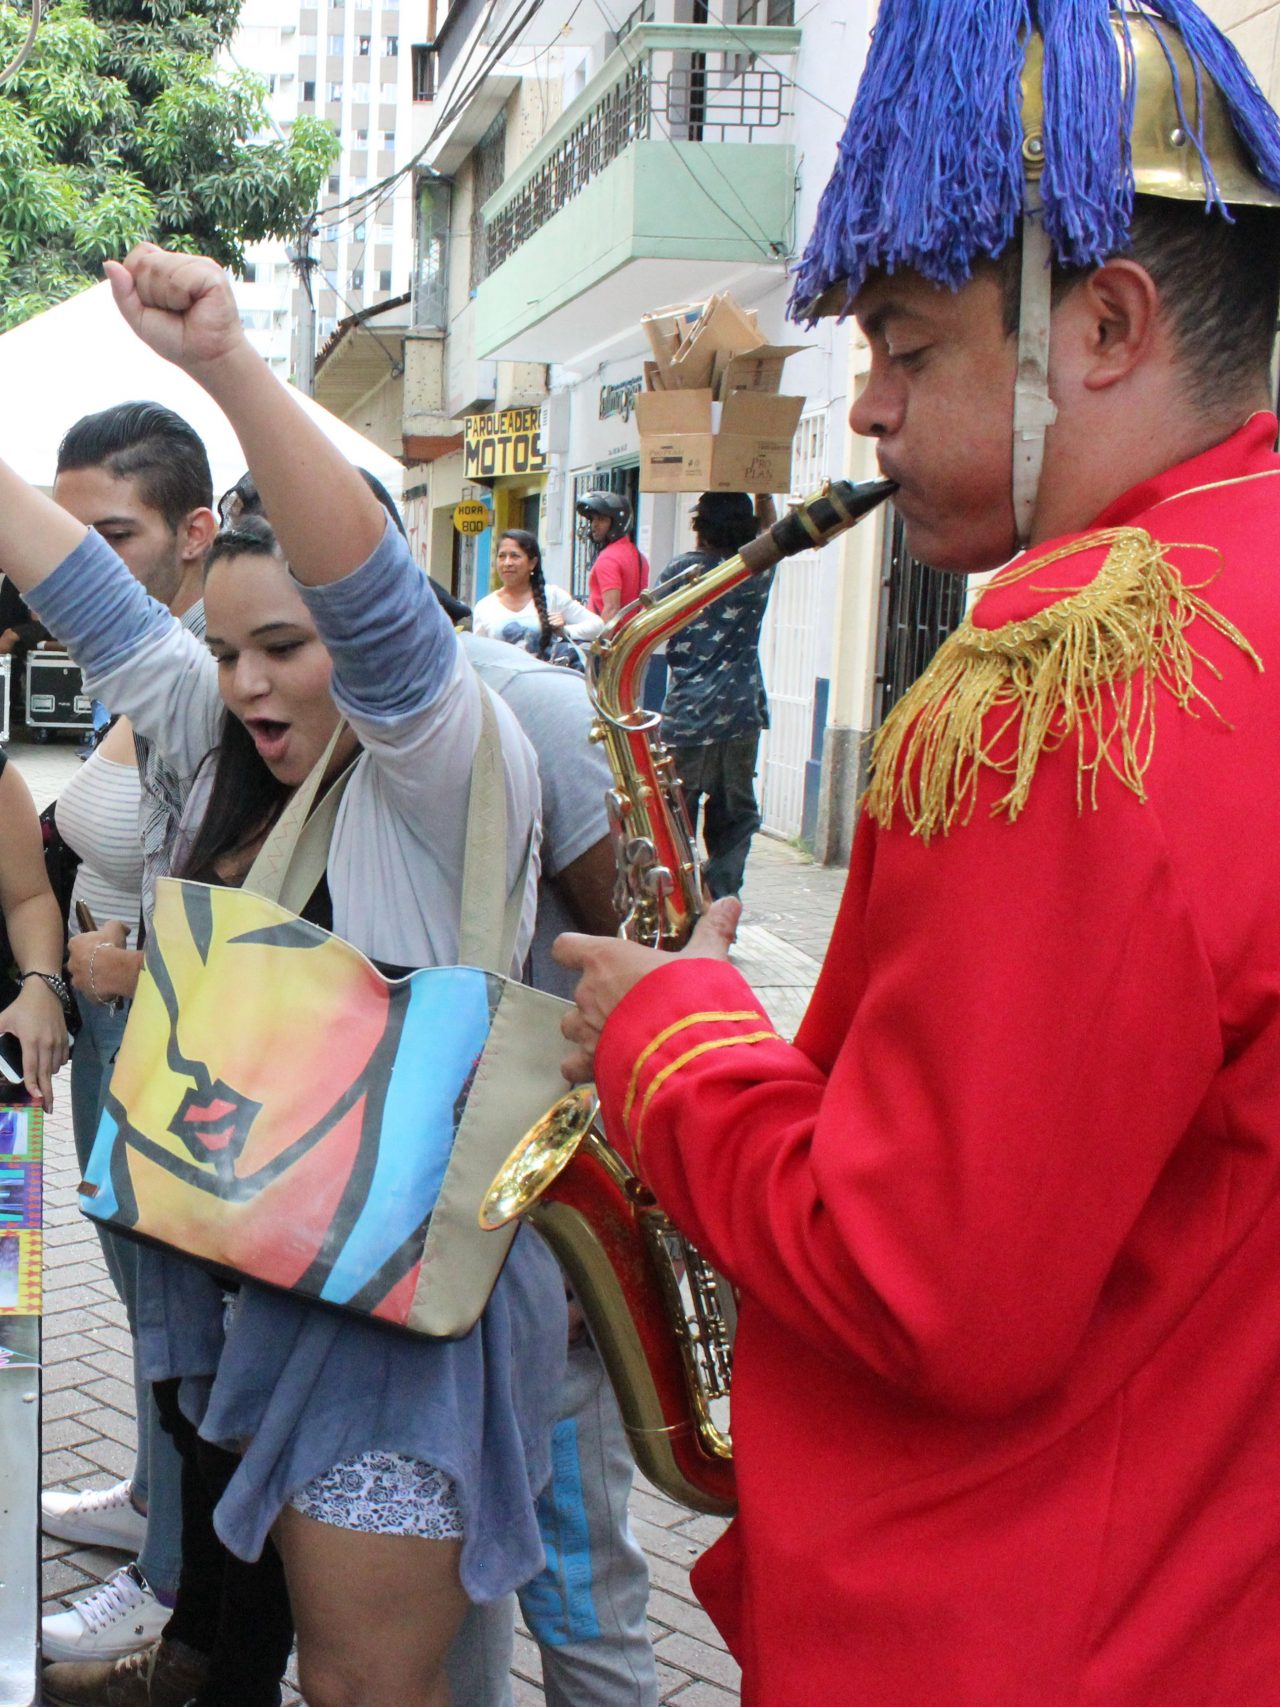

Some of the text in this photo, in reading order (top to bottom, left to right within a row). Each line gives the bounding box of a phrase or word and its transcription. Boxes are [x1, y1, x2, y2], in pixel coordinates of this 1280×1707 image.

[465, 433, 546, 476] MOTOS
[458, 505, 483, 515] HORA
[462, 520, 484, 532] 800
